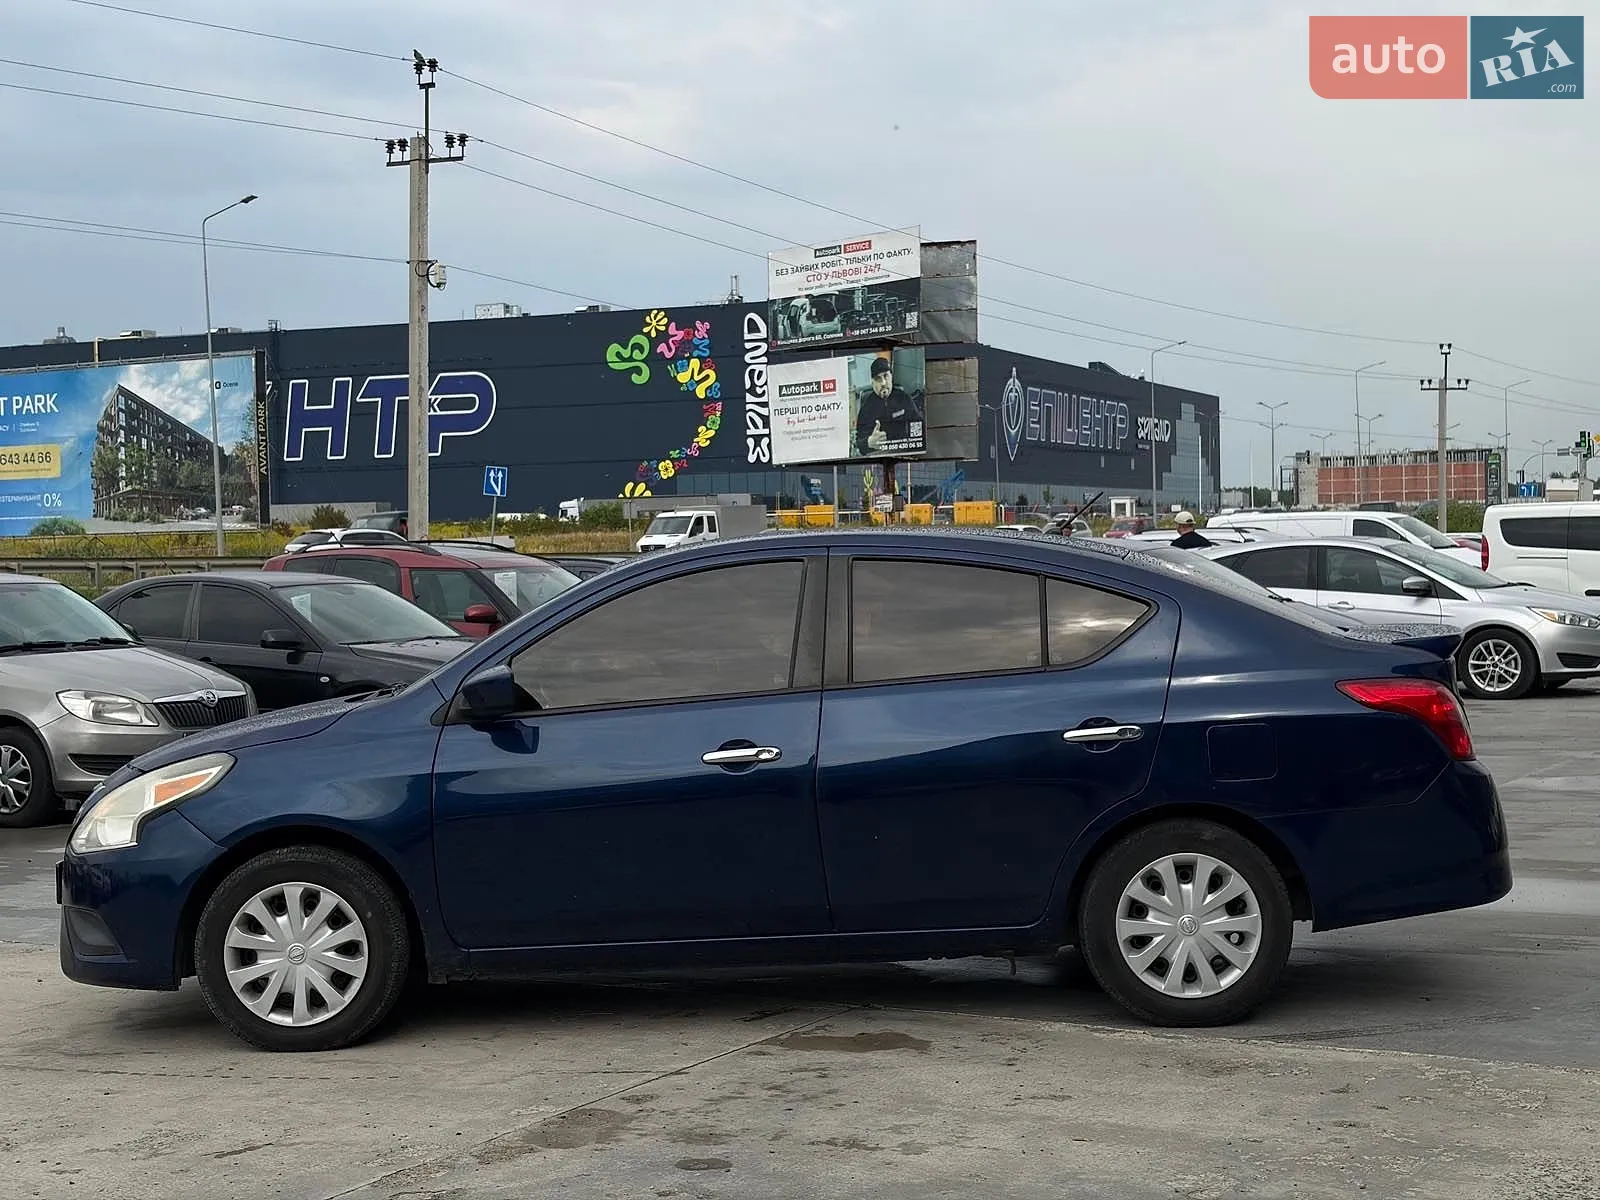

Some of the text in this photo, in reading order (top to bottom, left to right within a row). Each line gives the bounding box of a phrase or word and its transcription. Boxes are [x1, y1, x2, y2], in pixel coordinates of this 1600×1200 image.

[845, 241, 870, 253] SERVICE
[775, 267, 789, 277] БЕЗ
[790, 262, 820, 274] ЗАЙВИХ
[846, 254, 872, 266] ТІЛЬКИ
[873, 251, 885, 261] ПО
[806, 274, 822, 284] СТО
[832, 267, 862, 279] ЛЬВОВІ
[864, 263, 881, 274] 24/7
[781, 382, 818, 395] Autopark
[12, 393, 60, 416] PARK
[773, 406, 800, 416] ПЕРШІ
[801, 404, 813, 414] ПО
[260, 371, 497, 462] НТР
[1025, 386, 1130, 450] ЕПІЦЕНТР
[257, 401, 268, 475] AVANT PARK
[23, 452, 35, 464] 44
[37, 451, 52, 464] 66
[43, 492, 62, 507] 0%
